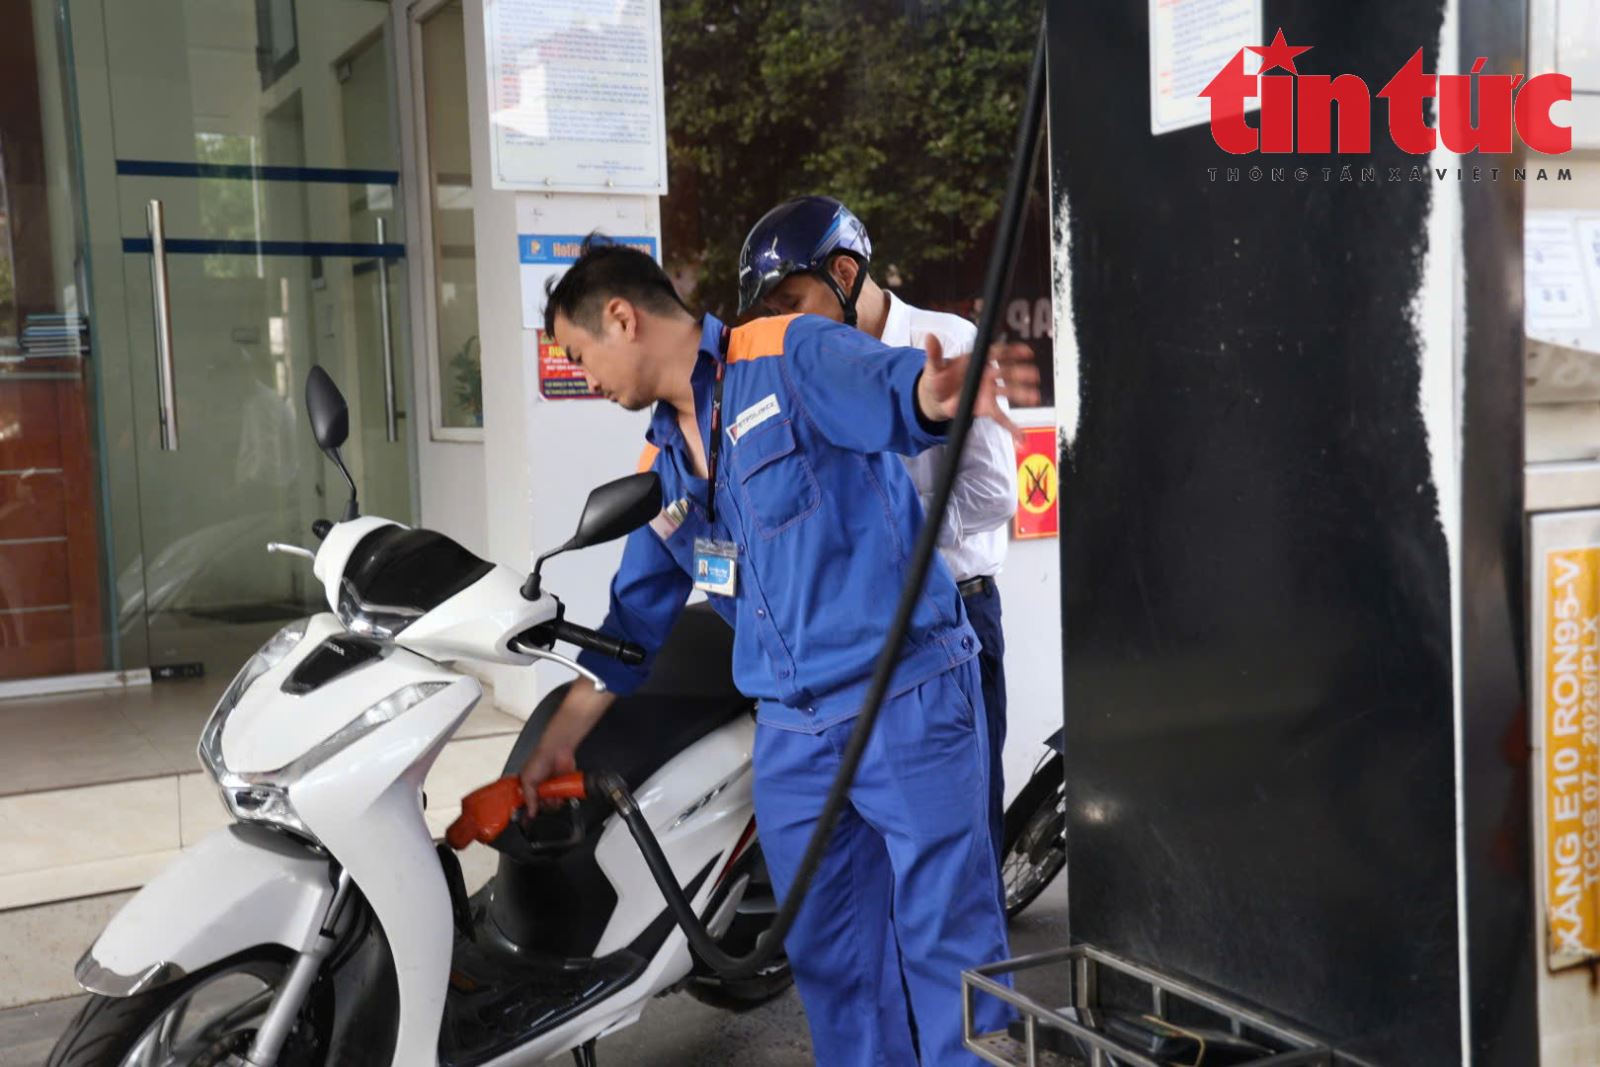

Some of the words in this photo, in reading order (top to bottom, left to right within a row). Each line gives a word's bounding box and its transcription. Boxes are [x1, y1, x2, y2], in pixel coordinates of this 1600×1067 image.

[1552, 557, 1581, 737] RON95-V
[1552, 747, 1581, 823] E10
[1582, 770, 1600, 803] 07
[1582, 809, 1600, 889] TCCS
[1550, 831, 1583, 948] XĂNG
